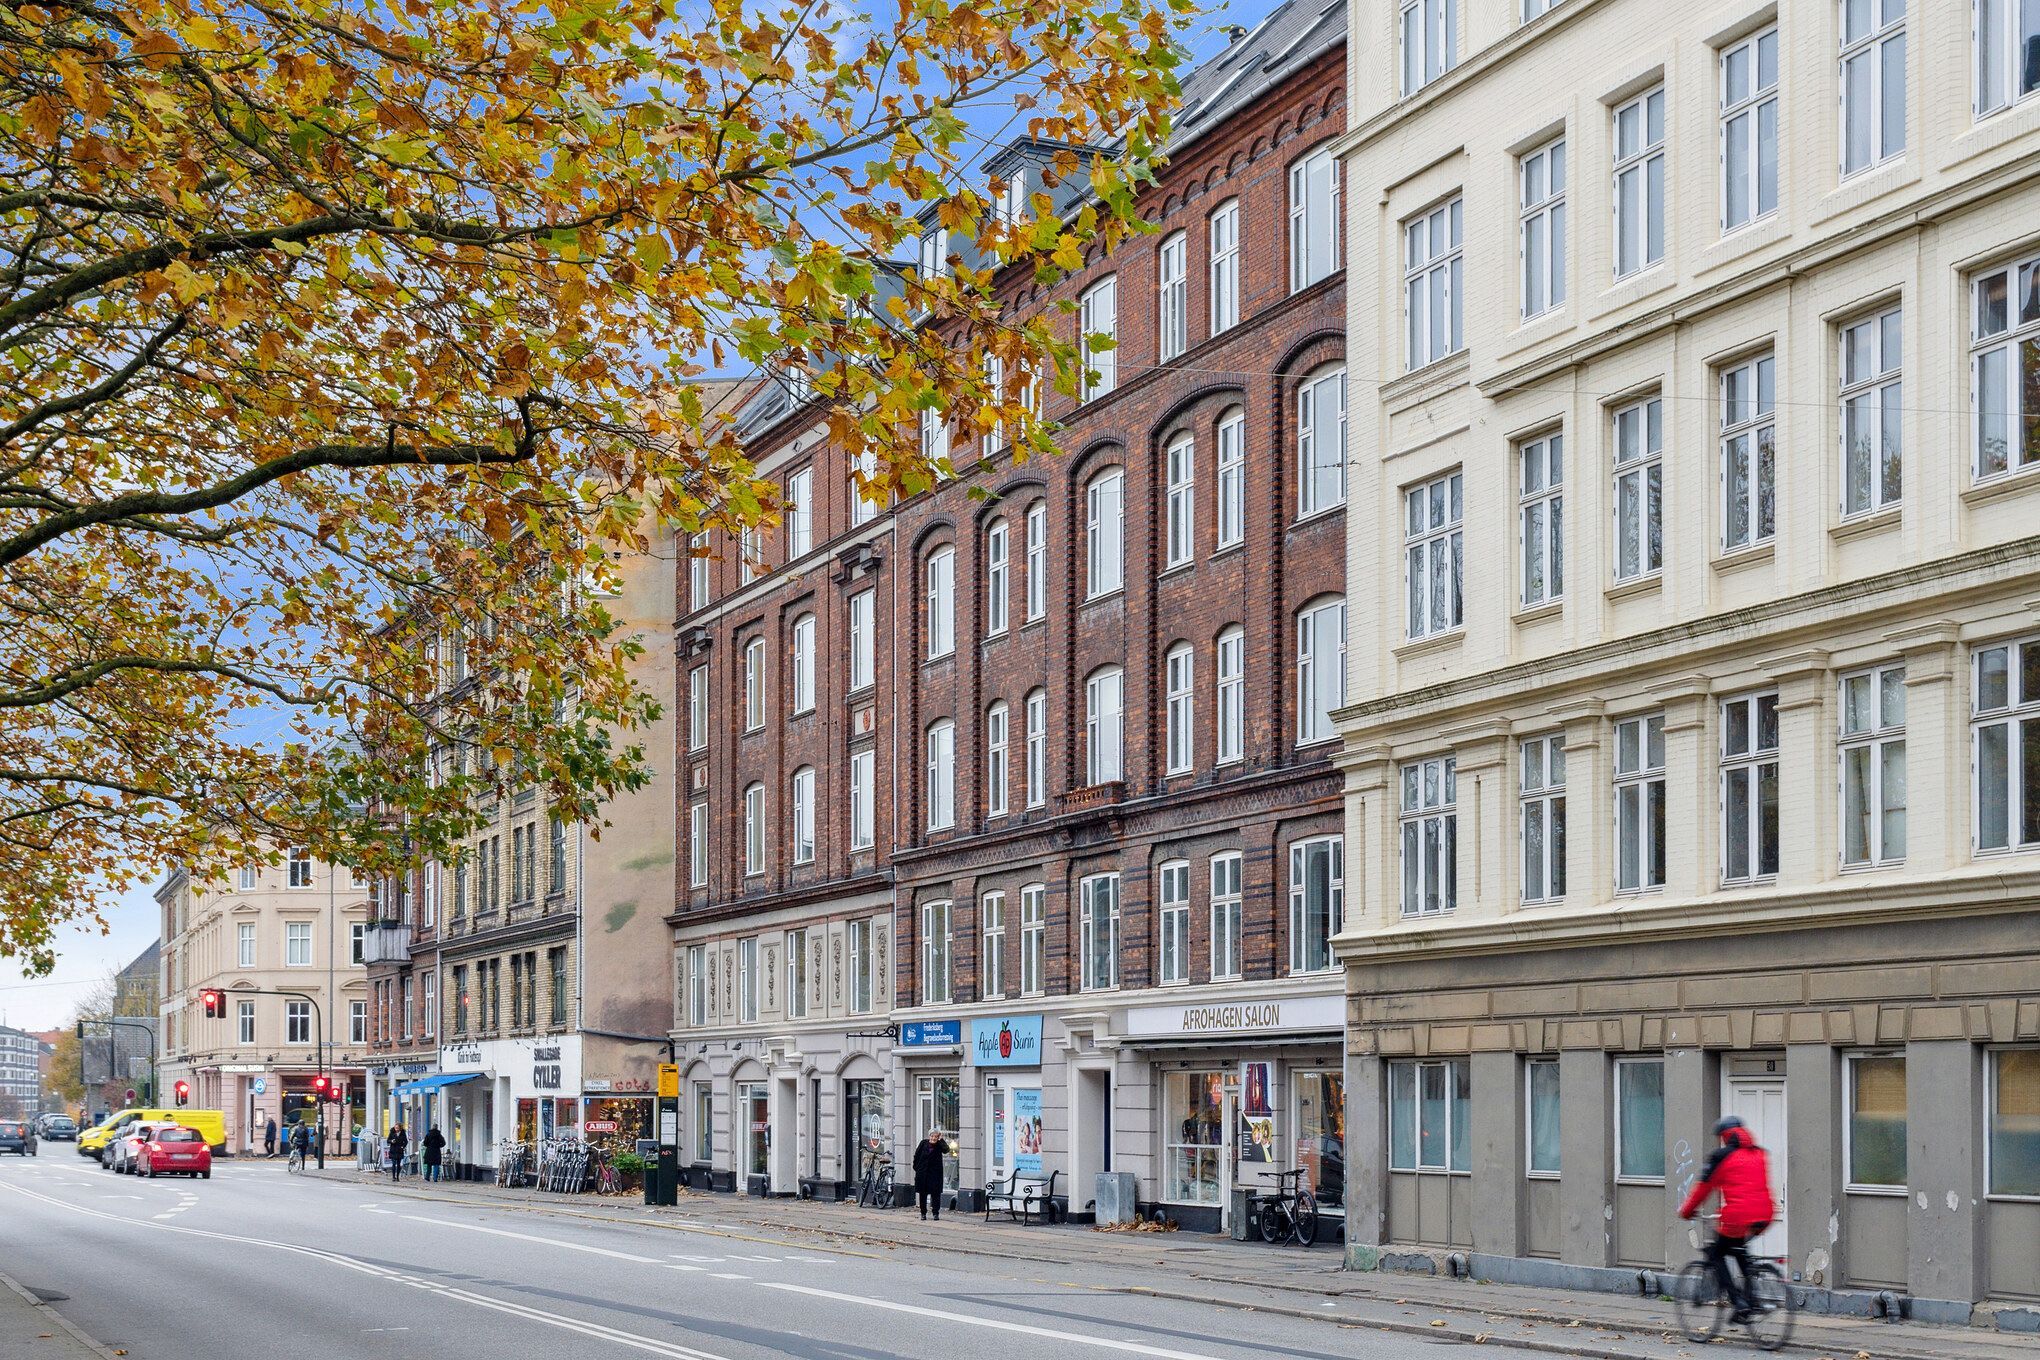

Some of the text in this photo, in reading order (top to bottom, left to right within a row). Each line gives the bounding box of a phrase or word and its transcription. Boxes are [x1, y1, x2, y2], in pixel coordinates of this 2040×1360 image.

[1182, 1004, 1280, 1030] AFROHAGEN SALON
[978, 1031, 998, 1058] Apple
[1013, 1029, 1034, 1050] Surin
[533, 1065, 561, 1089] CYKLER
